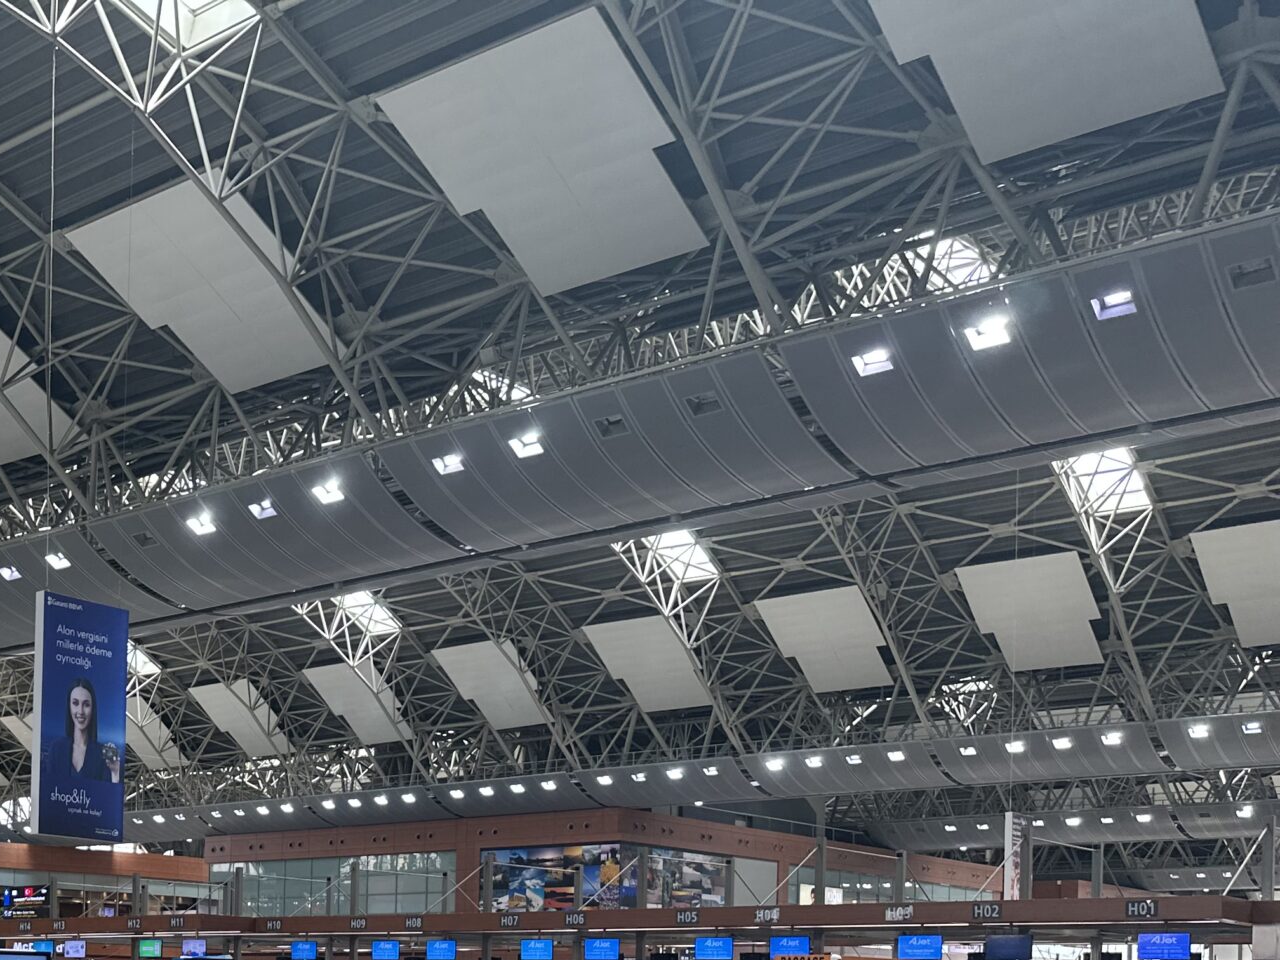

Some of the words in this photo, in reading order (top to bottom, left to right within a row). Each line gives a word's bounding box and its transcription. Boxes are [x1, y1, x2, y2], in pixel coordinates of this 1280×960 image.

[56, 624, 75, 636] Alan
[76, 630, 108, 644] vergisini
[56, 639, 84, 652] millerle
[86, 644, 112, 658] ödeme
[50, 786, 91, 808] shop&fly
[974, 905, 999, 918] H02
[1128, 902, 1155, 915] H01
[501, 916, 518, 926] H07
[566, 914, 584, 925] H06
[677, 912, 697, 922] H05
[20, 922, 31, 931] H14
[53, 921, 65, 929] H13
[128, 920, 140, 928] H12
[171, 918, 184, 927] H11
[267, 921, 281, 930] H10
[351, 919, 366, 928] H09
[406, 918, 422, 927] H08
